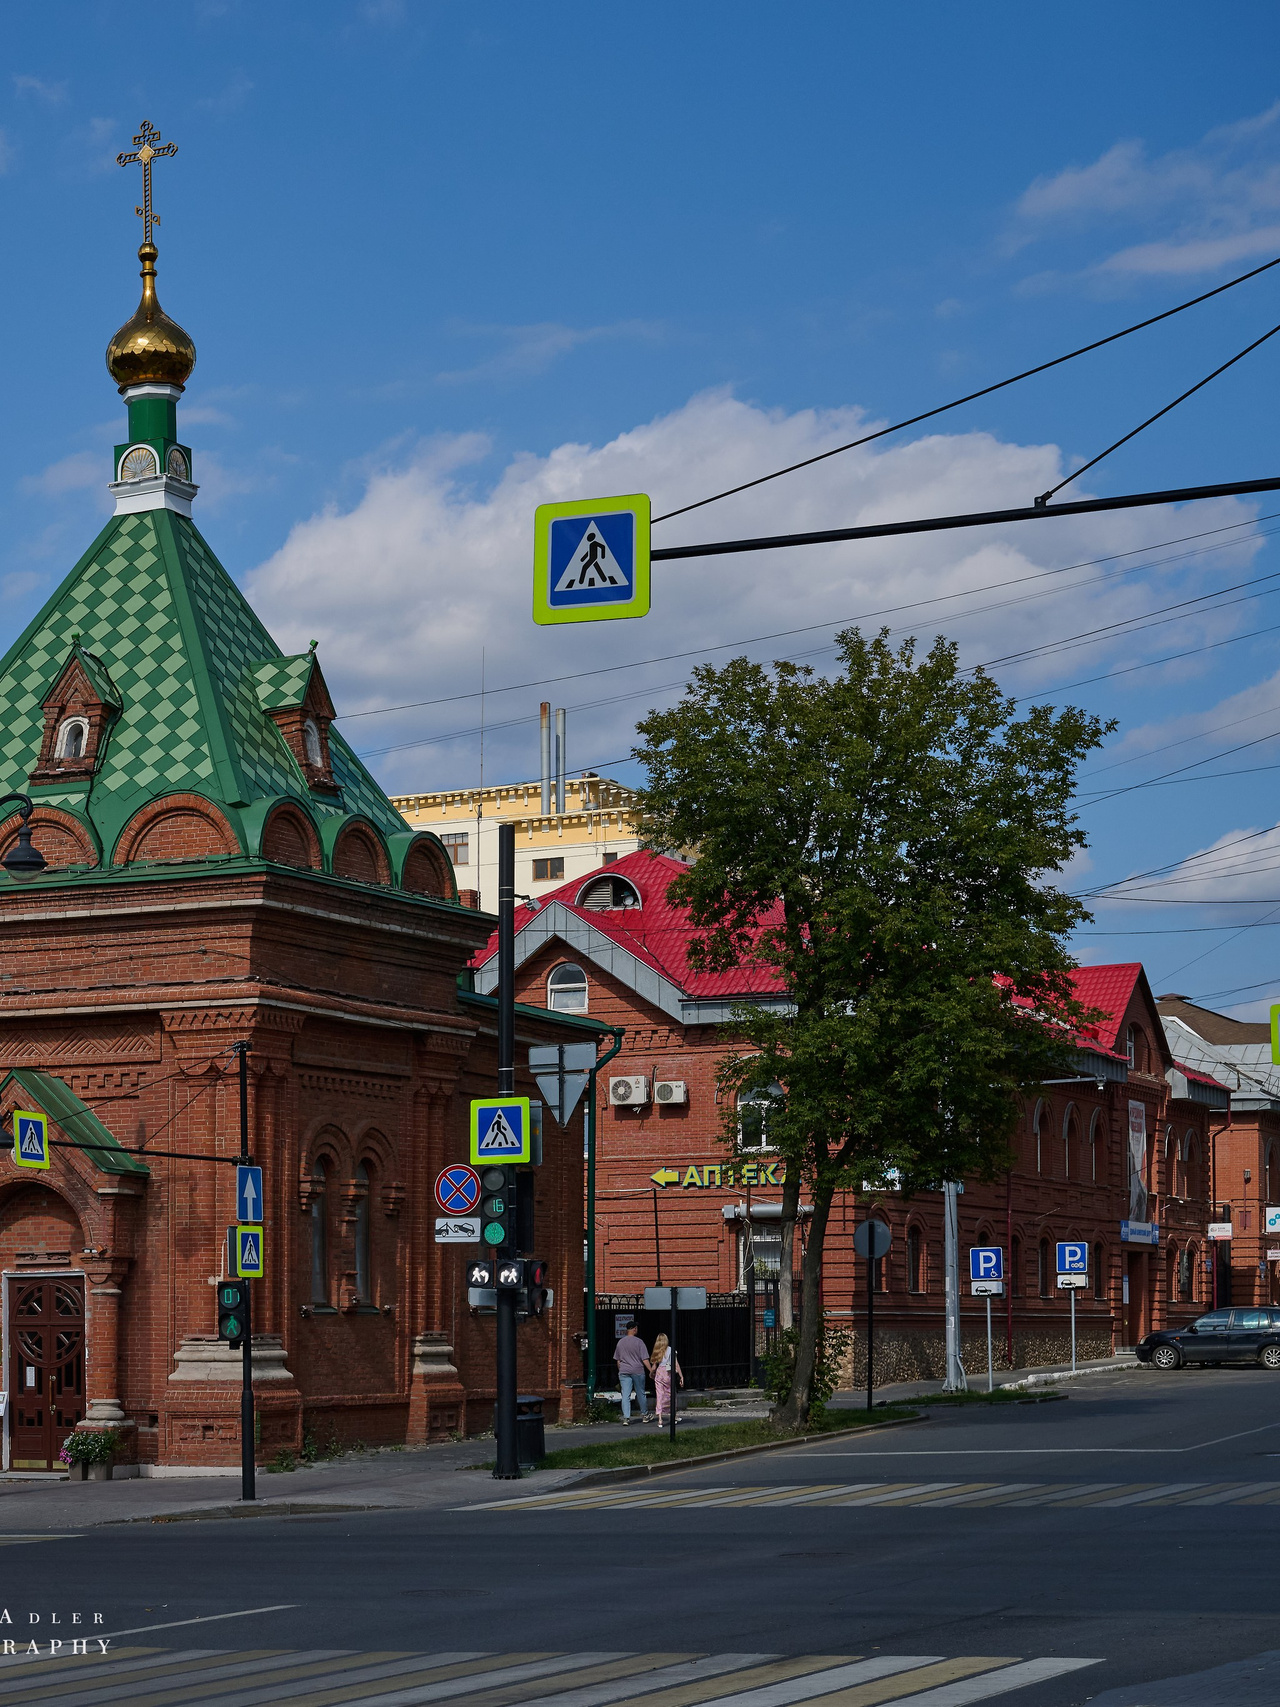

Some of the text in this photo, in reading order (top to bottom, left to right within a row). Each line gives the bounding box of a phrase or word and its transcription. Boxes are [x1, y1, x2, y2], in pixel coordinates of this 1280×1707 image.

[681, 1163, 802, 1187] АПТЕК
[492, 1198, 504, 1213] 16
[979, 1251, 997, 1276] P
[1065, 1246, 1081, 1269] P
